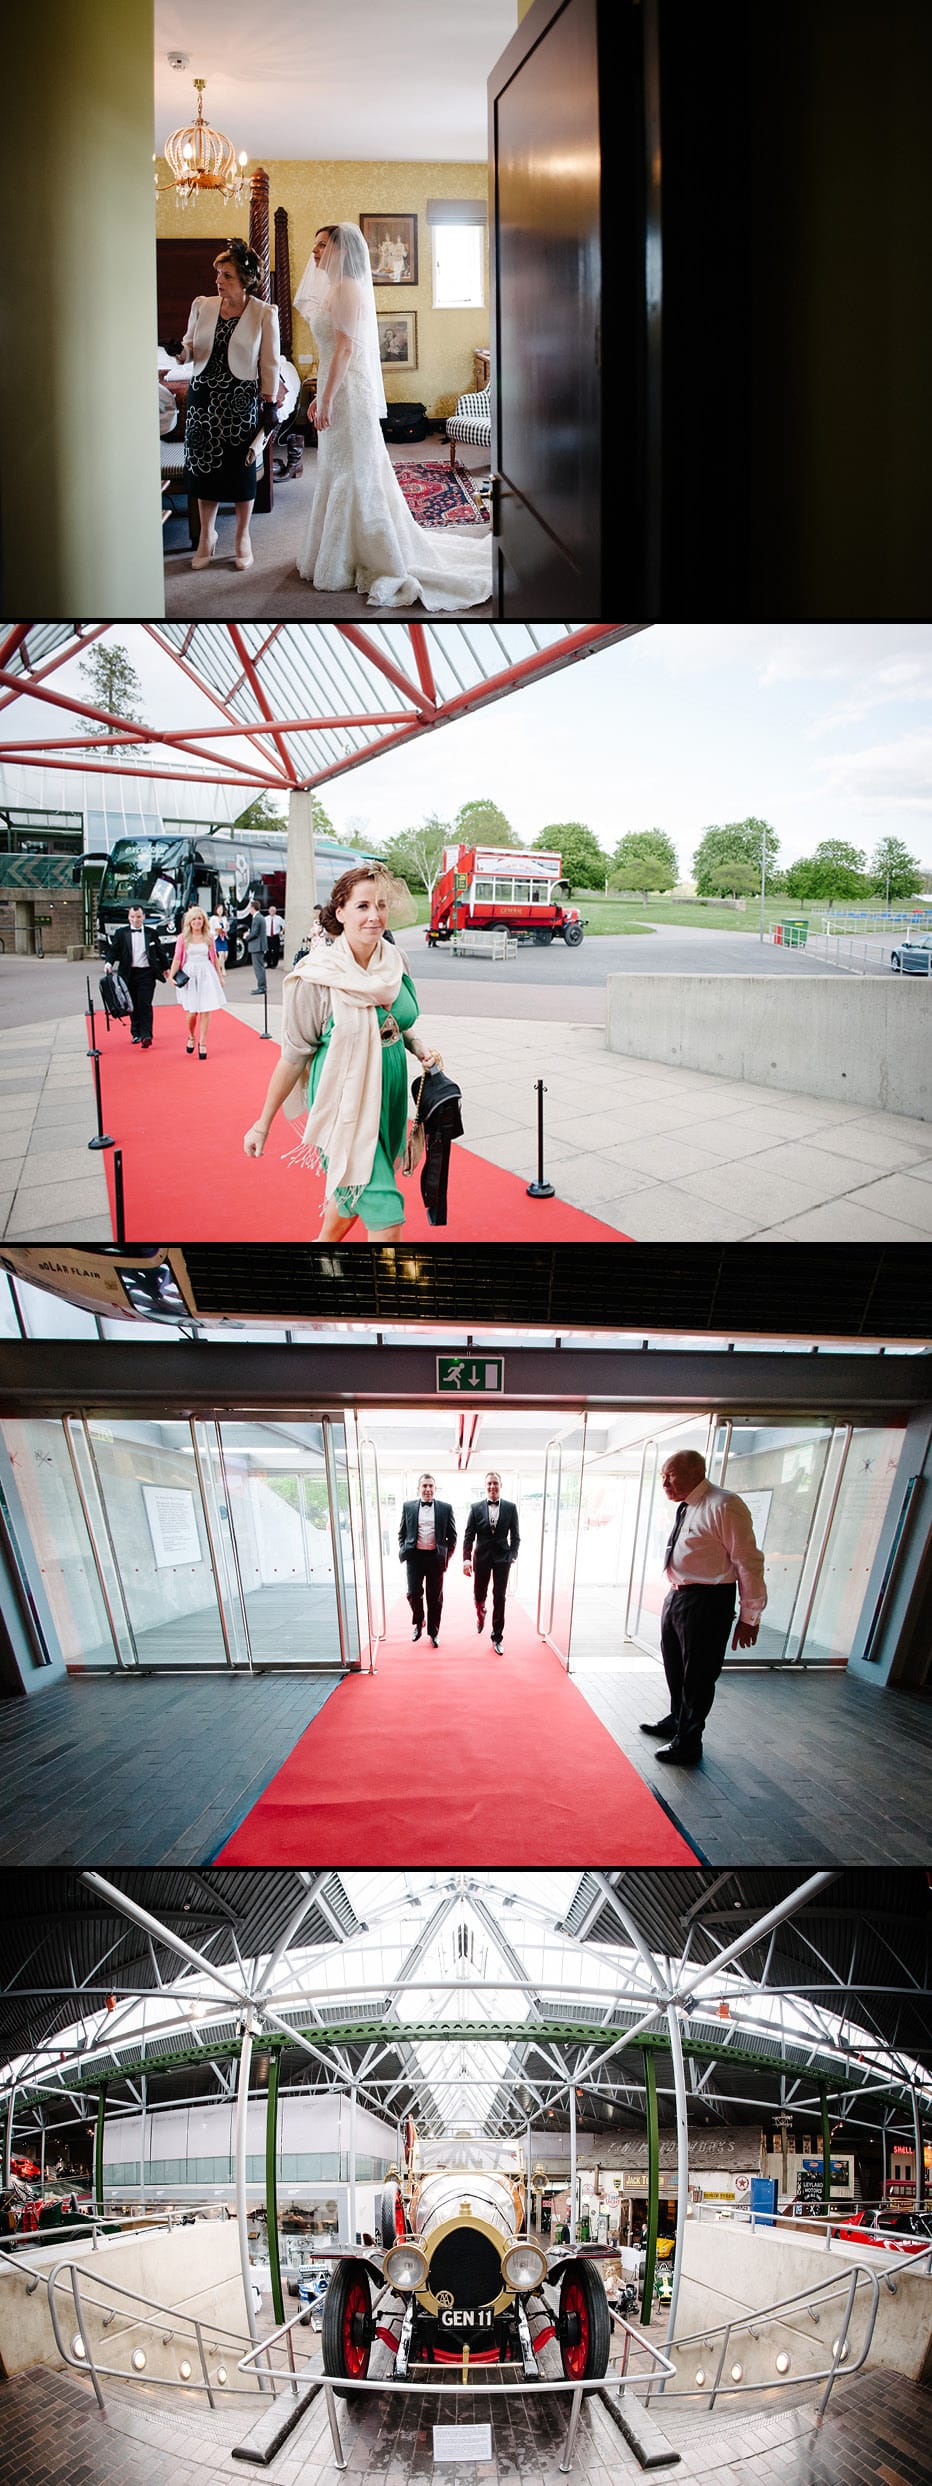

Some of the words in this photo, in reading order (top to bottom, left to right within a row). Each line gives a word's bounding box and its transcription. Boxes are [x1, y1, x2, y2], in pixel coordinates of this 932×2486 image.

[70, 1267, 101, 1279] FLAIR
[893, 2145, 913, 2154] SHELL
[625, 2175, 641, 2185] JACK
[441, 2310, 475, 2326] GEN
[478, 2310, 492, 2326] 11
